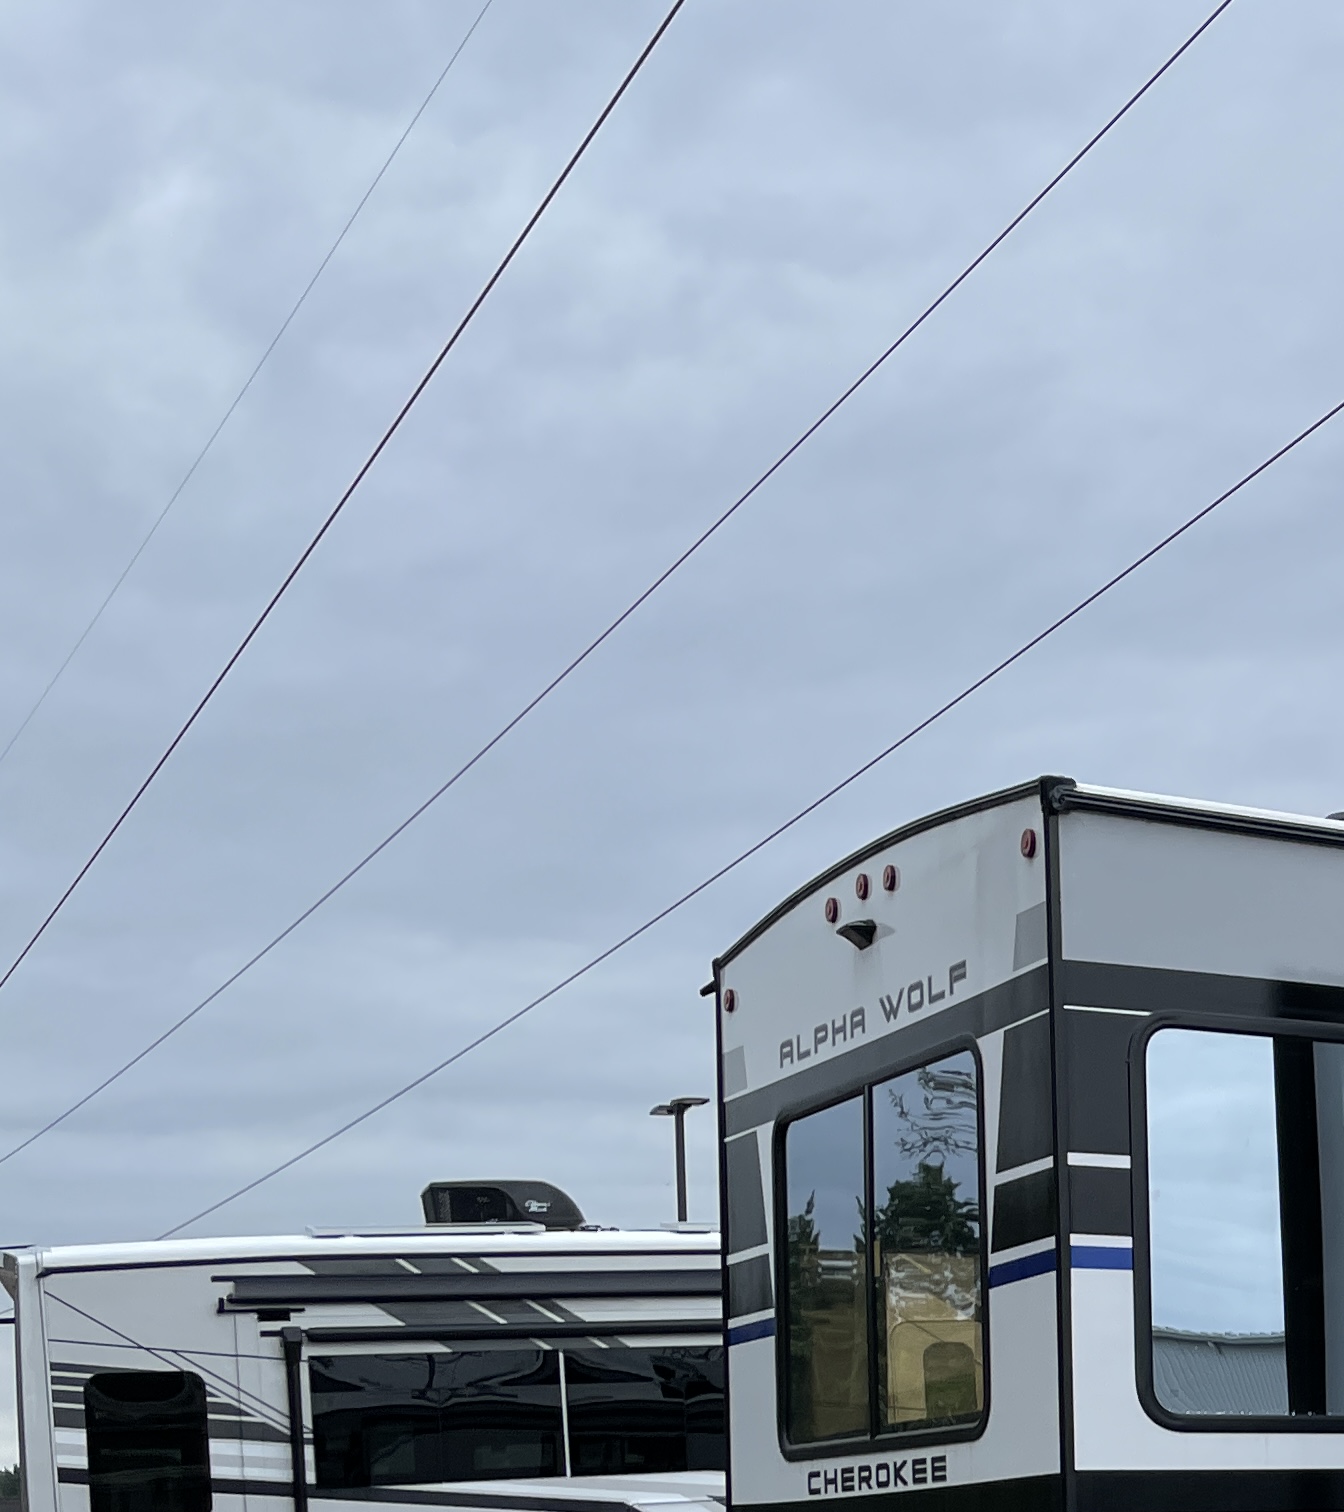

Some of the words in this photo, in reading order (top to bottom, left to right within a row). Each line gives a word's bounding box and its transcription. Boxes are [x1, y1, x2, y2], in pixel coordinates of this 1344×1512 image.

[779, 1006, 866, 1069] ALPHA
[878, 959, 967, 1023] WOLF
[807, 1455, 947, 1495] CHEROKEE
